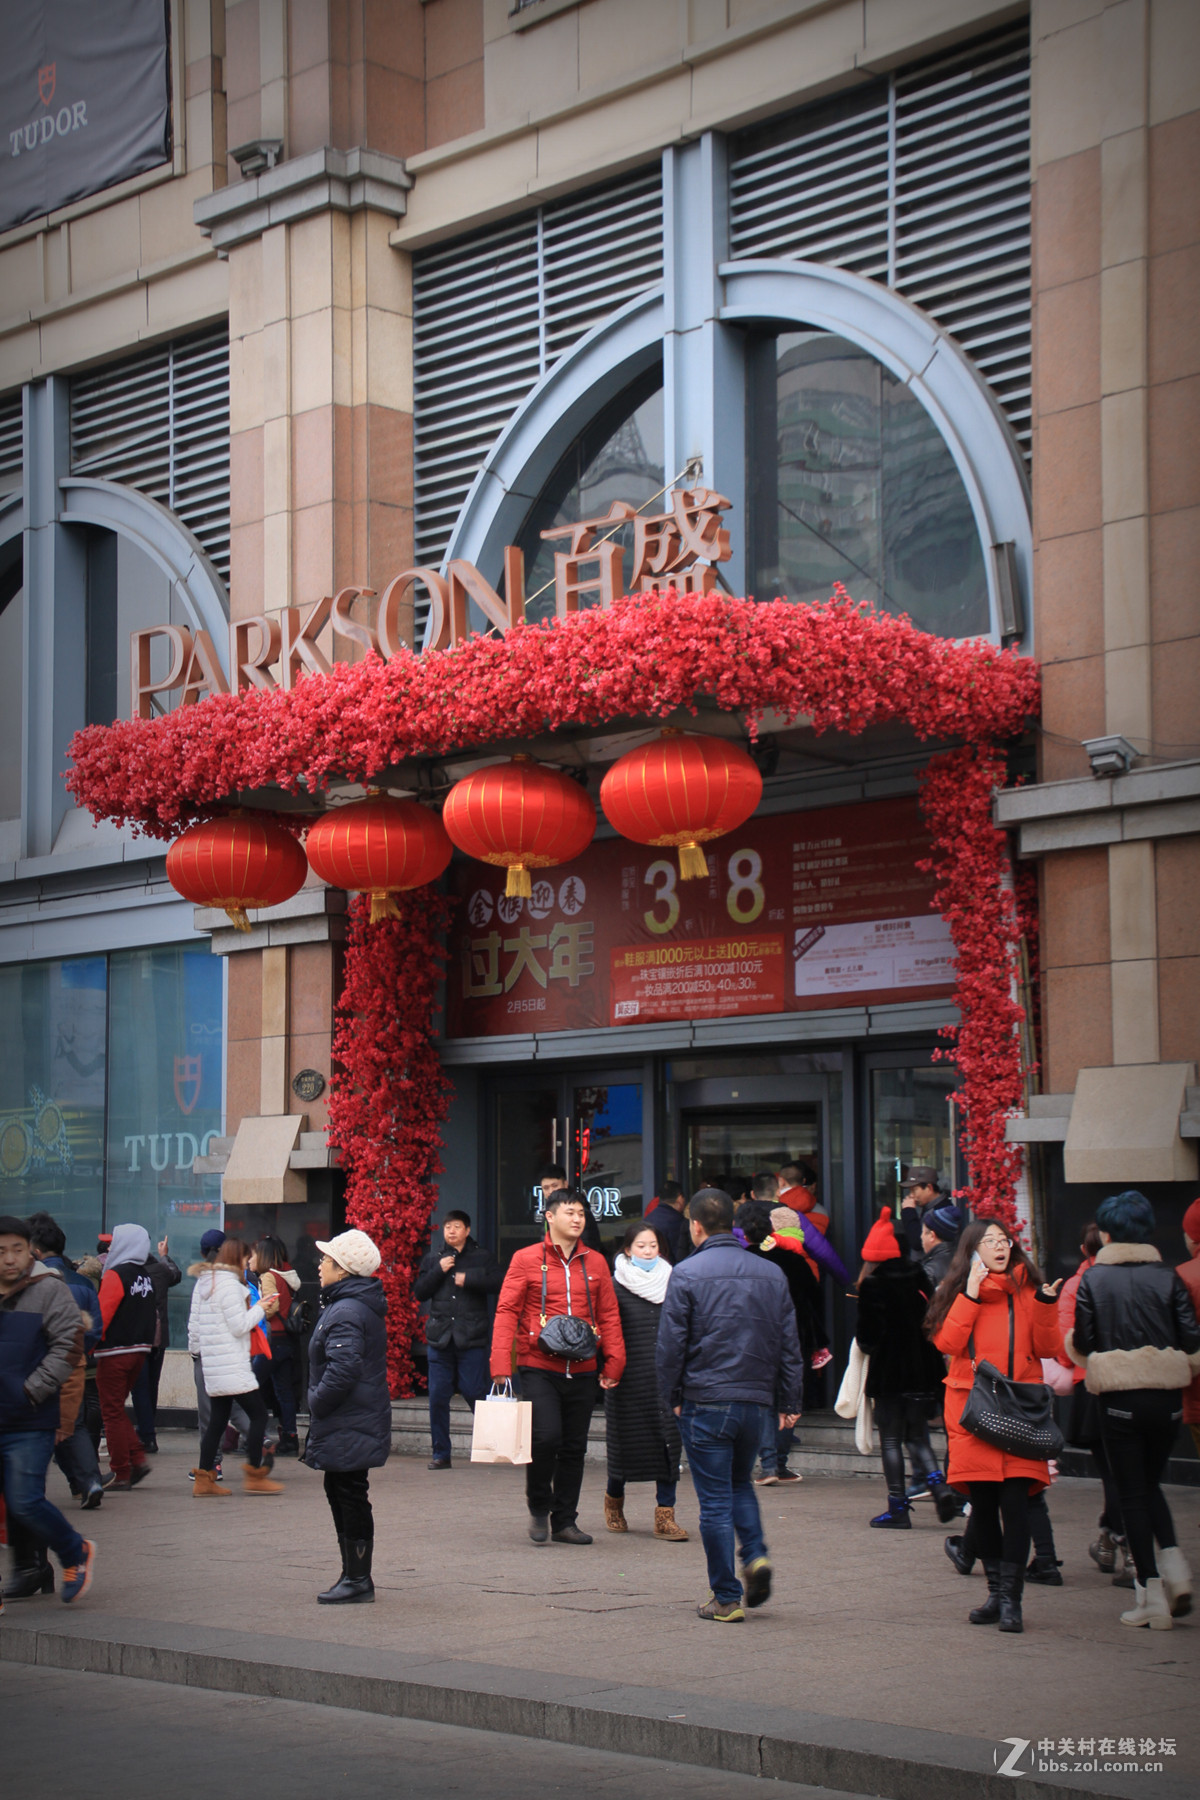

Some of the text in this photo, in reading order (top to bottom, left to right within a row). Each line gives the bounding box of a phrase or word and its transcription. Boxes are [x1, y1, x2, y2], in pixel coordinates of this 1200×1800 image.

[9, 99, 89, 157] TUDOR
[130, 488, 734, 722] PARKSON 百盛
[644, 860, 681, 934] 3
[726, 847, 766, 924] 8
[461, 921, 595, 999] 过大年
[507, 997, 547, 1014] 2月5日起
